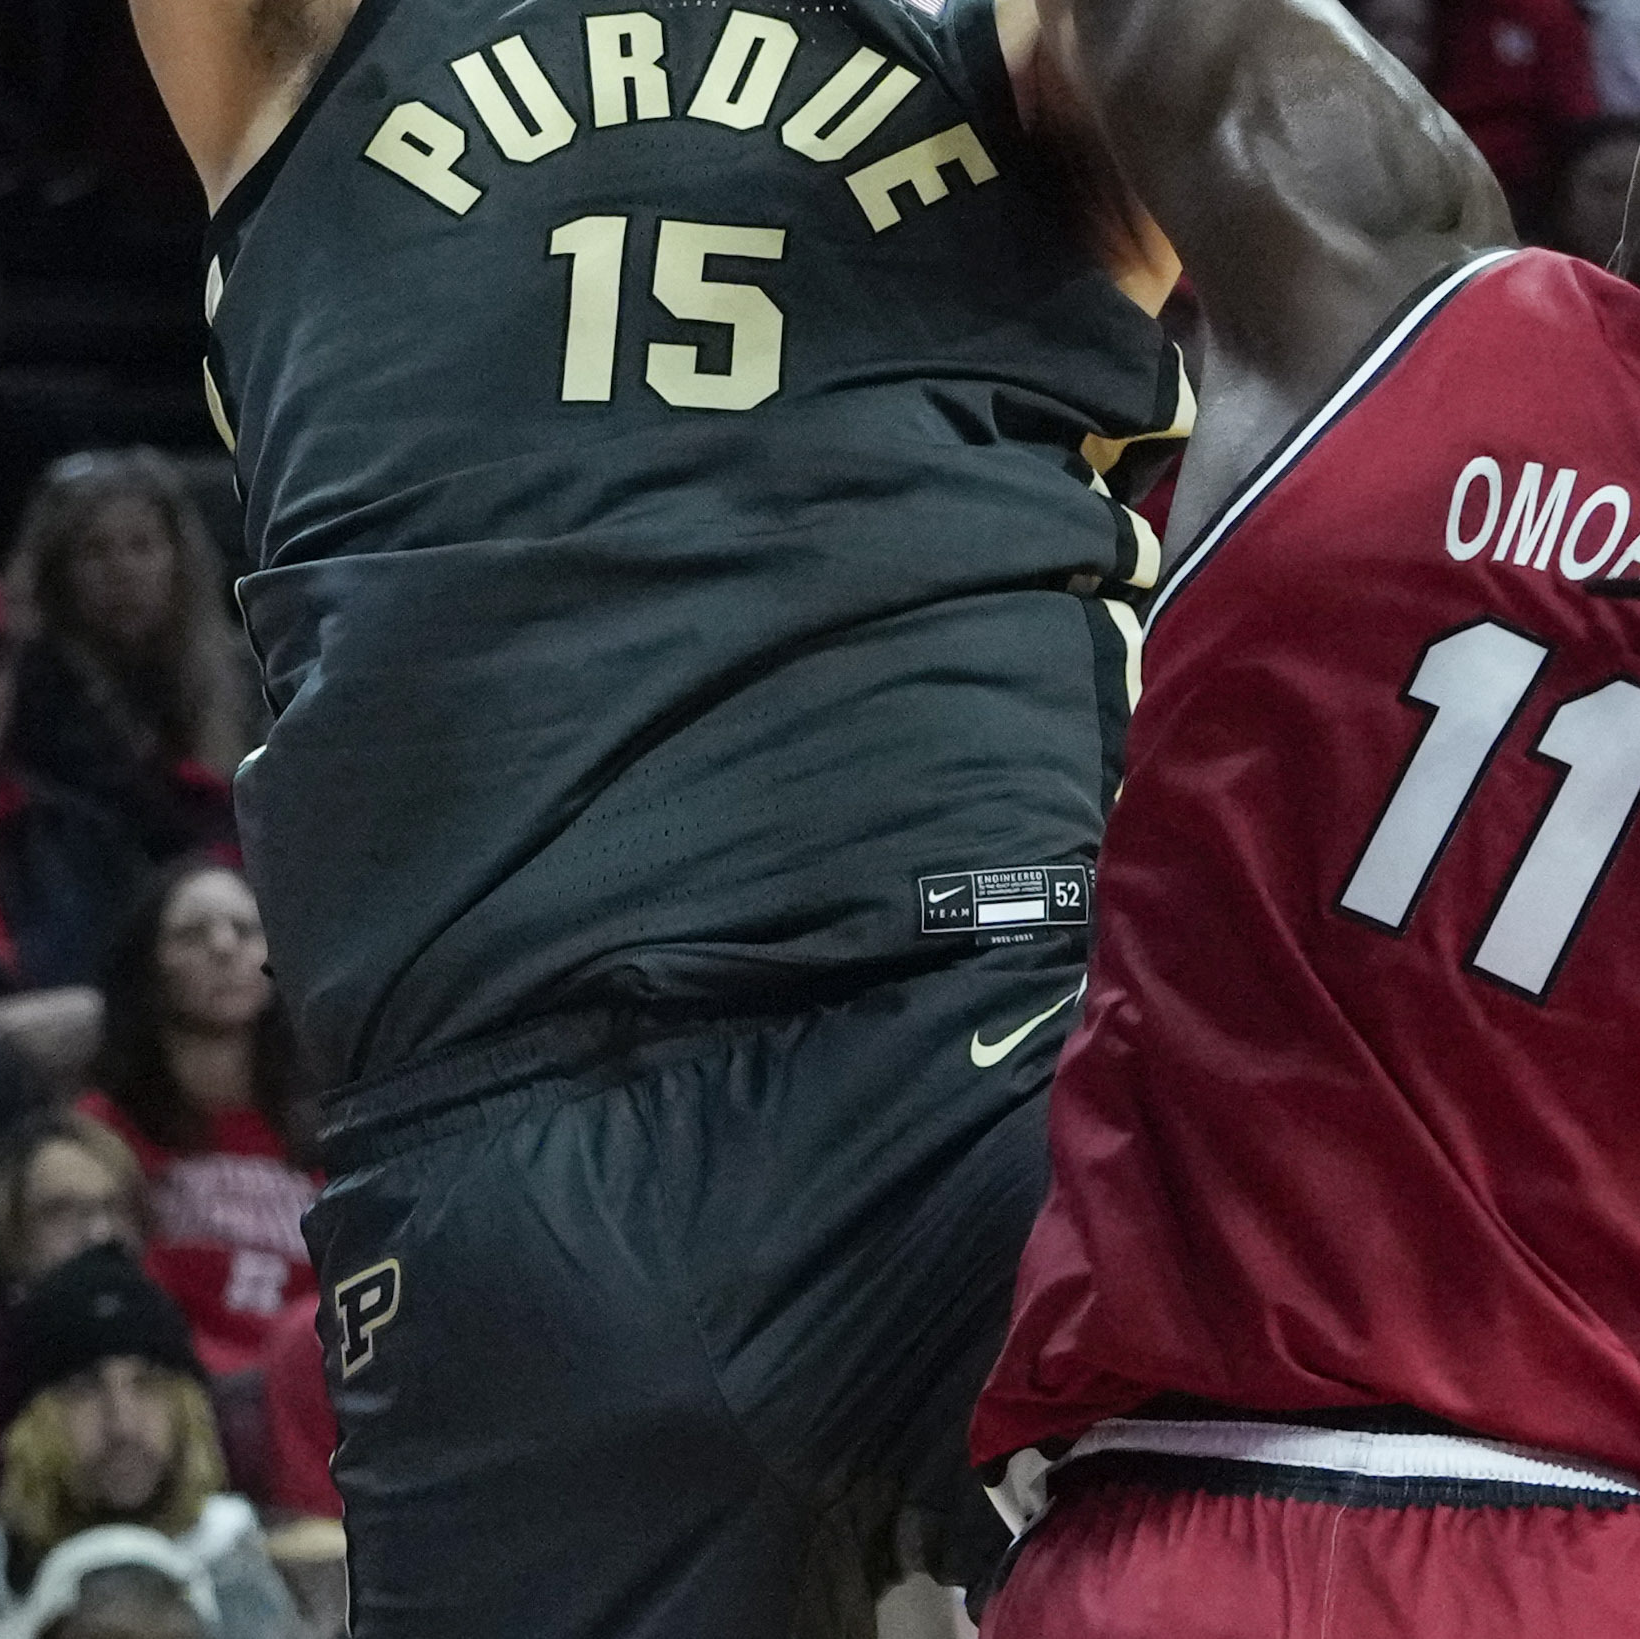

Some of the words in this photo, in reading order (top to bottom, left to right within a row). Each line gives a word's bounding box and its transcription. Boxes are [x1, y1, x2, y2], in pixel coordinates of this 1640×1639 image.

[364, 8, 1001, 235] PURDUE
[549, 215, 787, 411] 15
[928, 908, 970, 919] TEAM
[1055, 881, 1081, 907] 52
[335, 1258, 401, 1379] P
